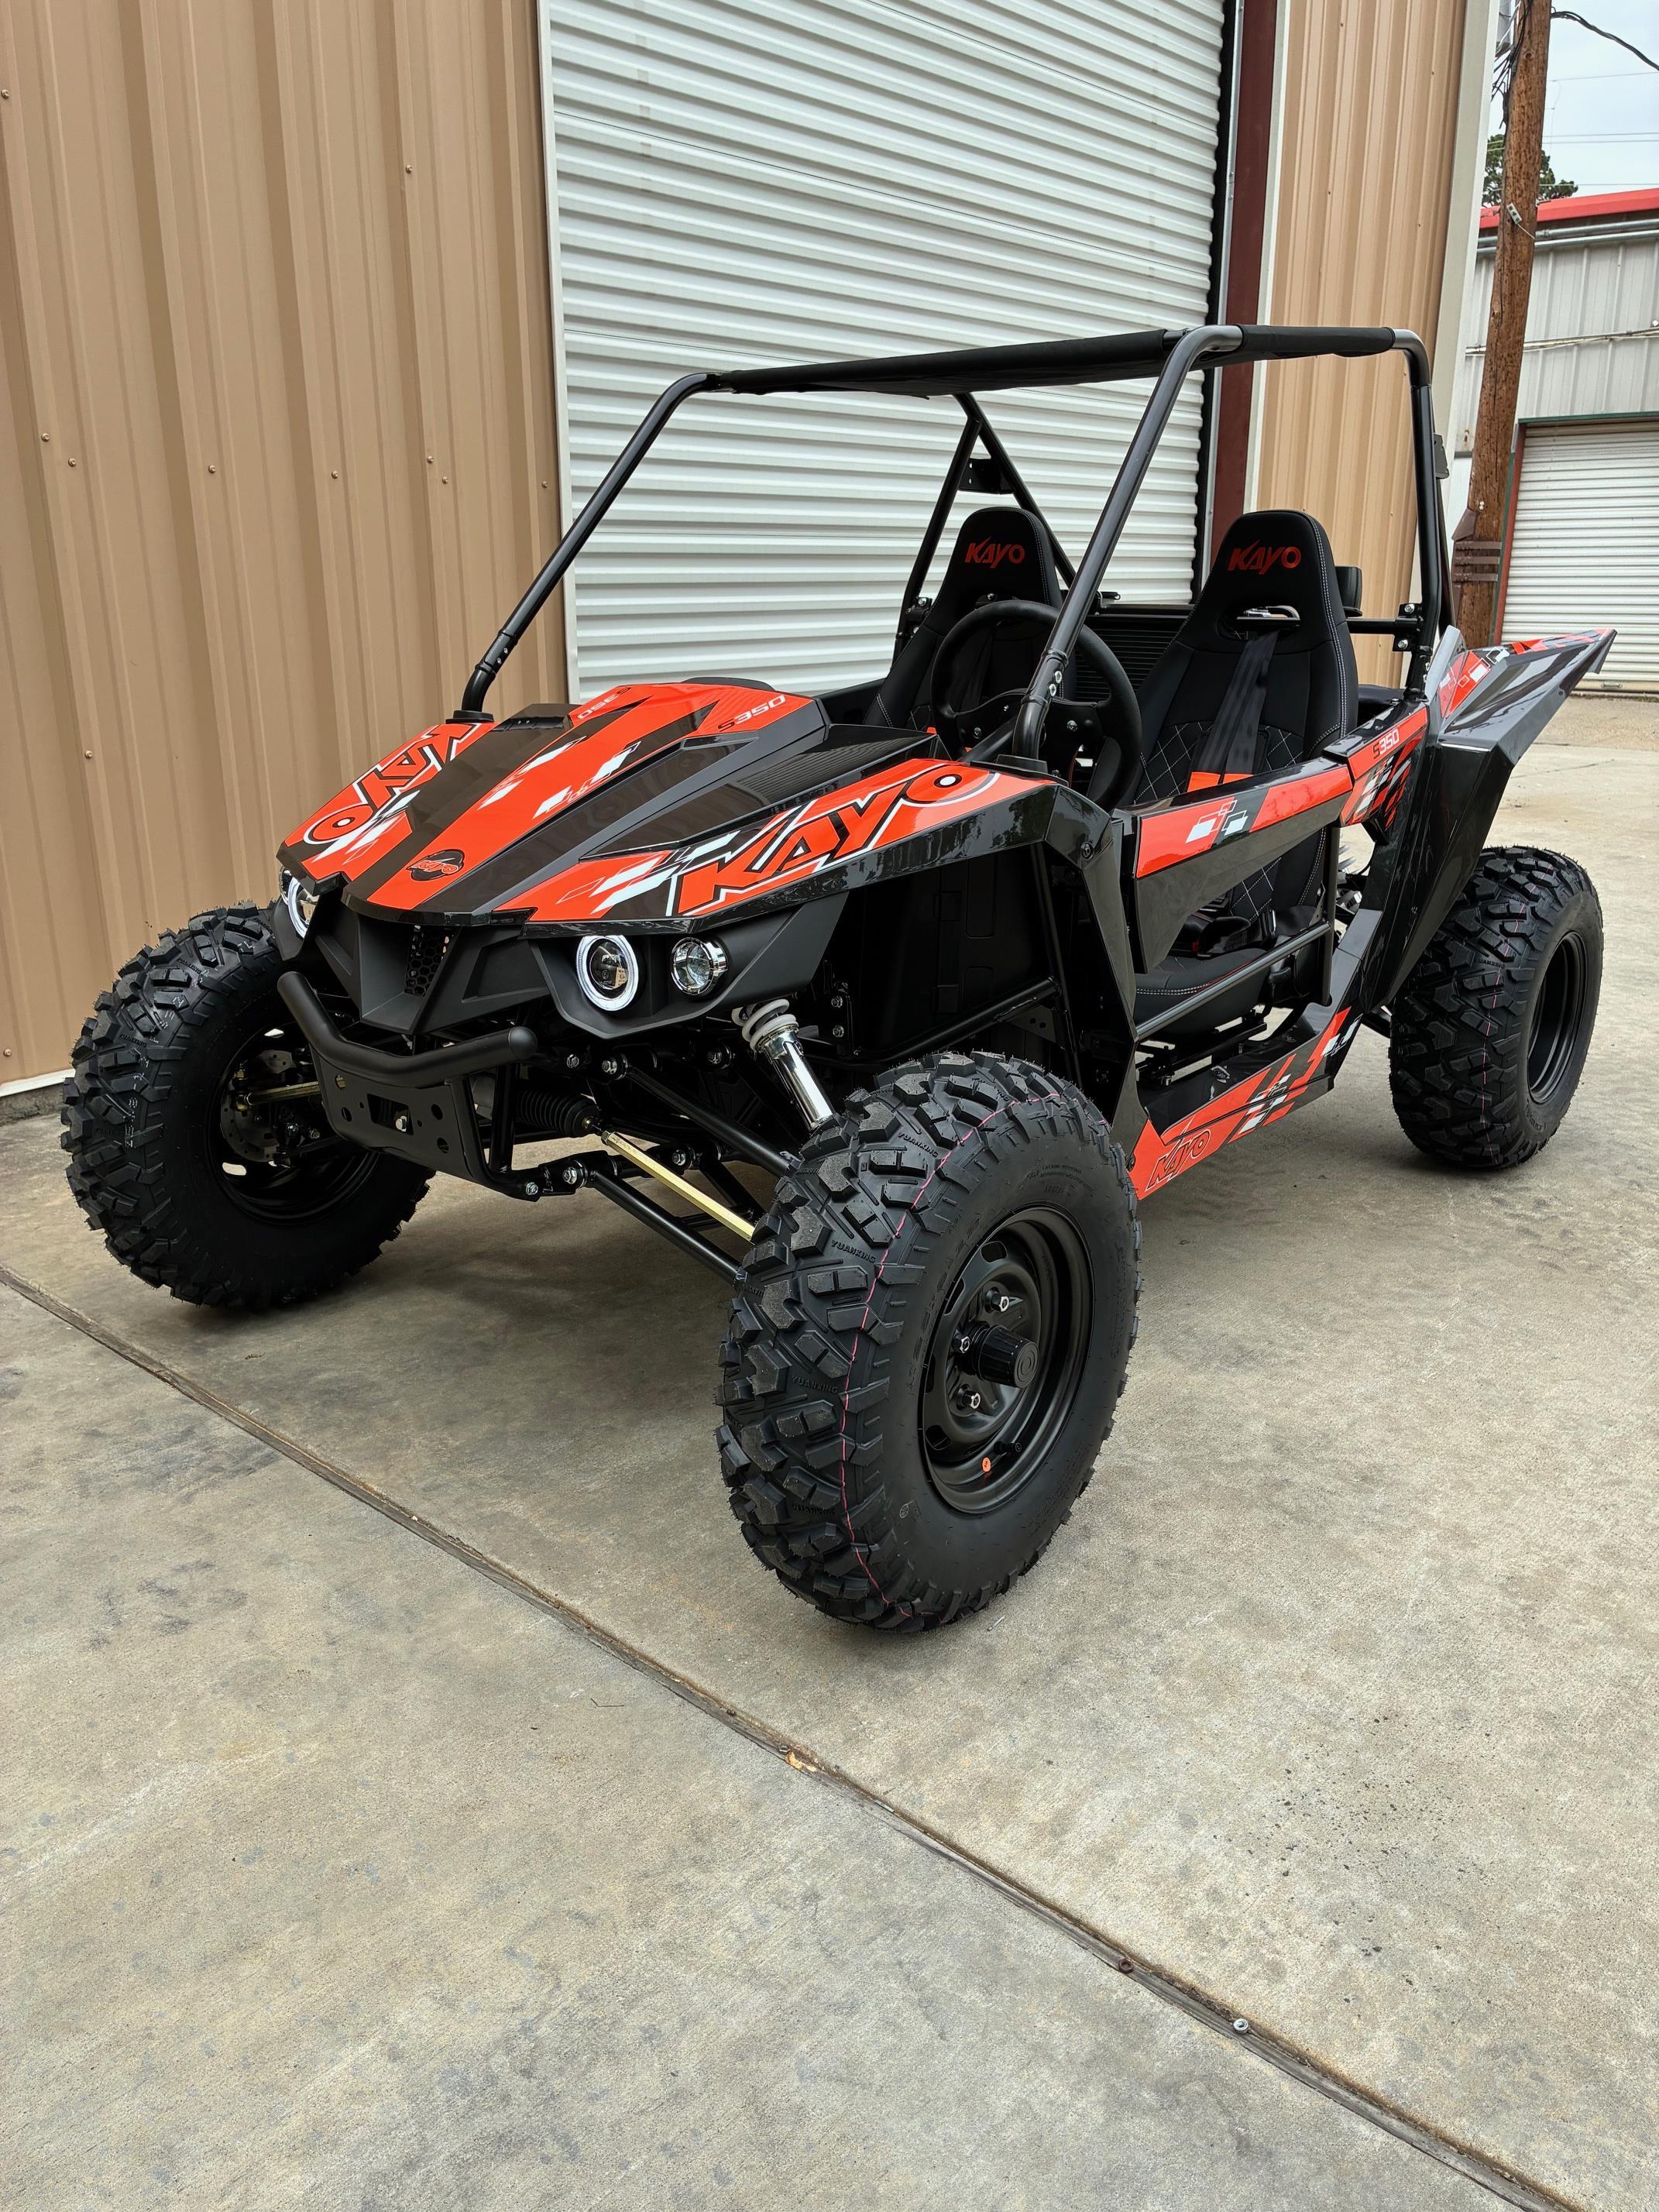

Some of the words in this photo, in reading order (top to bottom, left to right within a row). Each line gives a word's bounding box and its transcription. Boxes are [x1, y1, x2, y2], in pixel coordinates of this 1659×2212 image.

[965, 537, 1025, 568] KAYO
[1228, 540, 1302, 575] KAYO
[717, 694, 786, 732] S350
[1372, 727, 1400, 760] S350
[303, 723, 482, 844] KAYO
[668, 763, 999, 916] KAYO
[898, 1132, 939, 1158] YUANXING
[1145, 1128, 1211, 1192] KAYO
[831, 1239, 876, 1263] YUANXING
[792, 1375, 838, 1394] YUANXING
